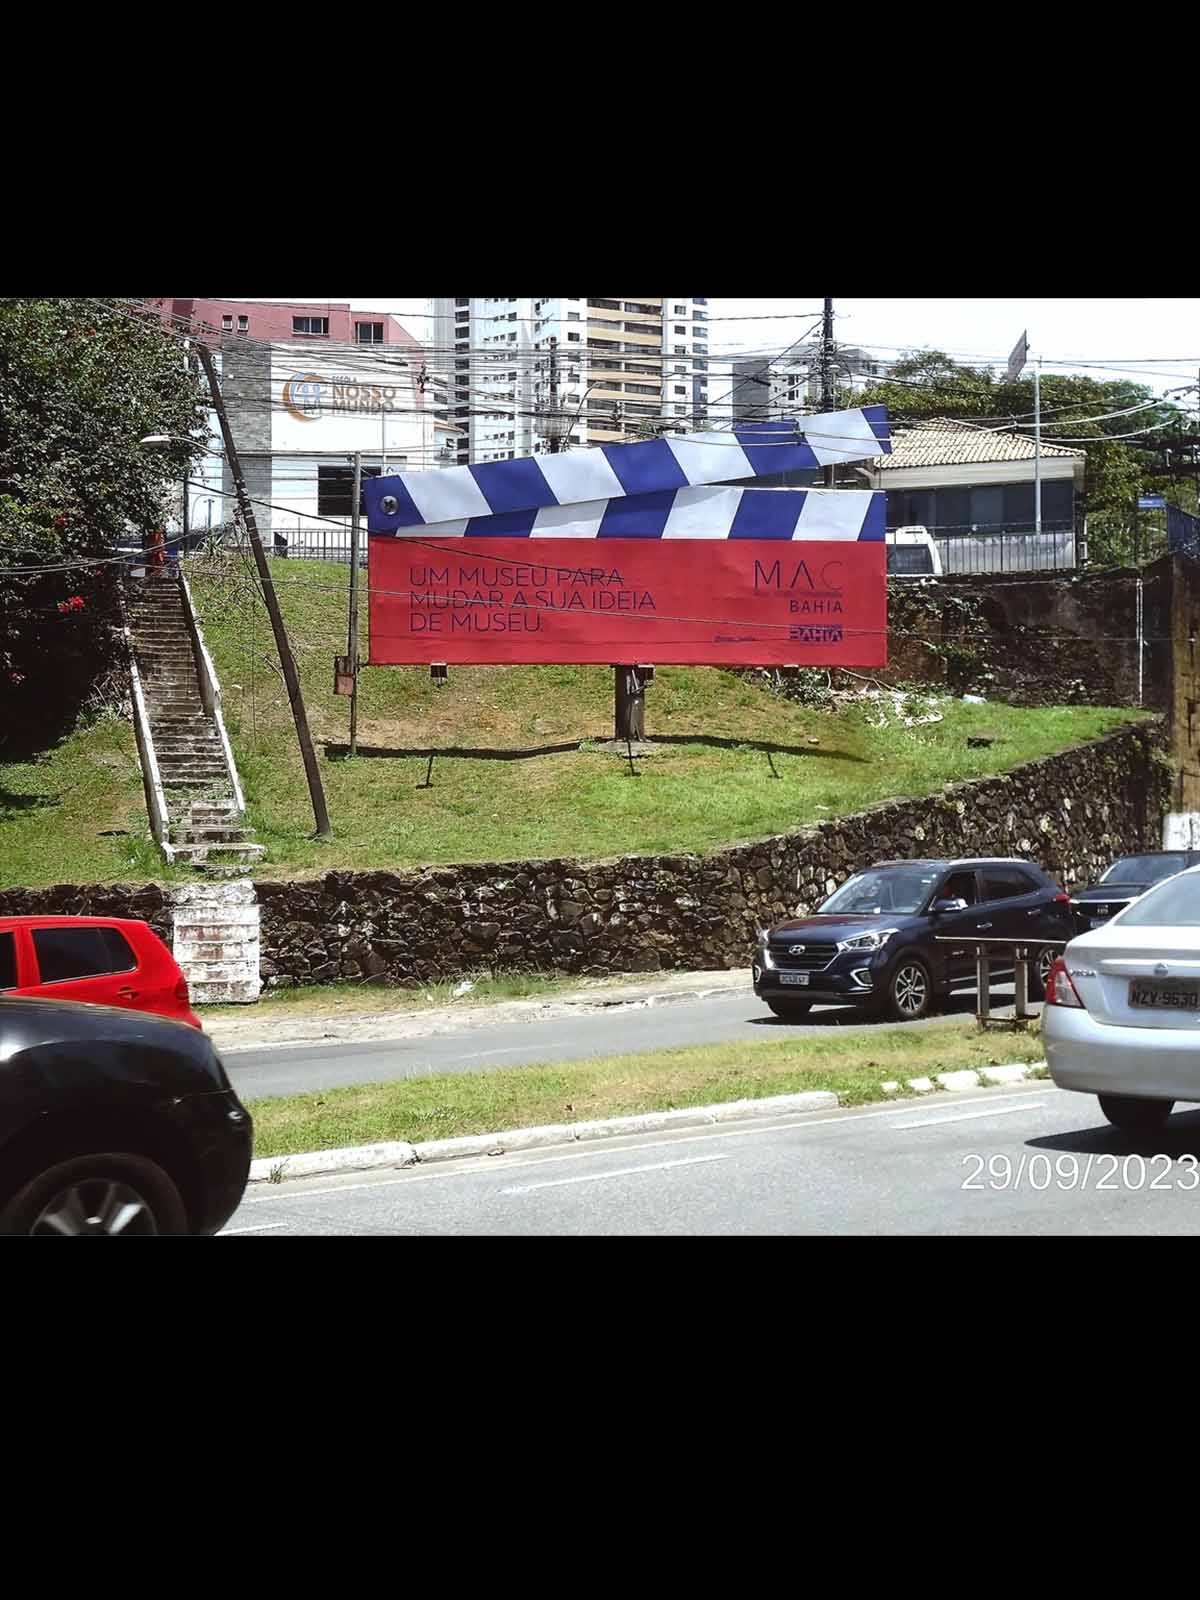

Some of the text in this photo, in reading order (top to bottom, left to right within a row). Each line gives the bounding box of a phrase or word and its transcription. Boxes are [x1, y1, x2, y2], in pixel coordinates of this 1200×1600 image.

[332, 384, 397, 400] NOSSO
[332, 399, 395, 416] MUNDO
[409, 567, 625, 588] UM MUSEU PARA
[754, 559, 843, 590] MAC
[409, 590, 657, 611] MUDAR A SUA IDEIA
[789, 599, 843, 613] BAHIA
[409, 612, 442, 633] DE
